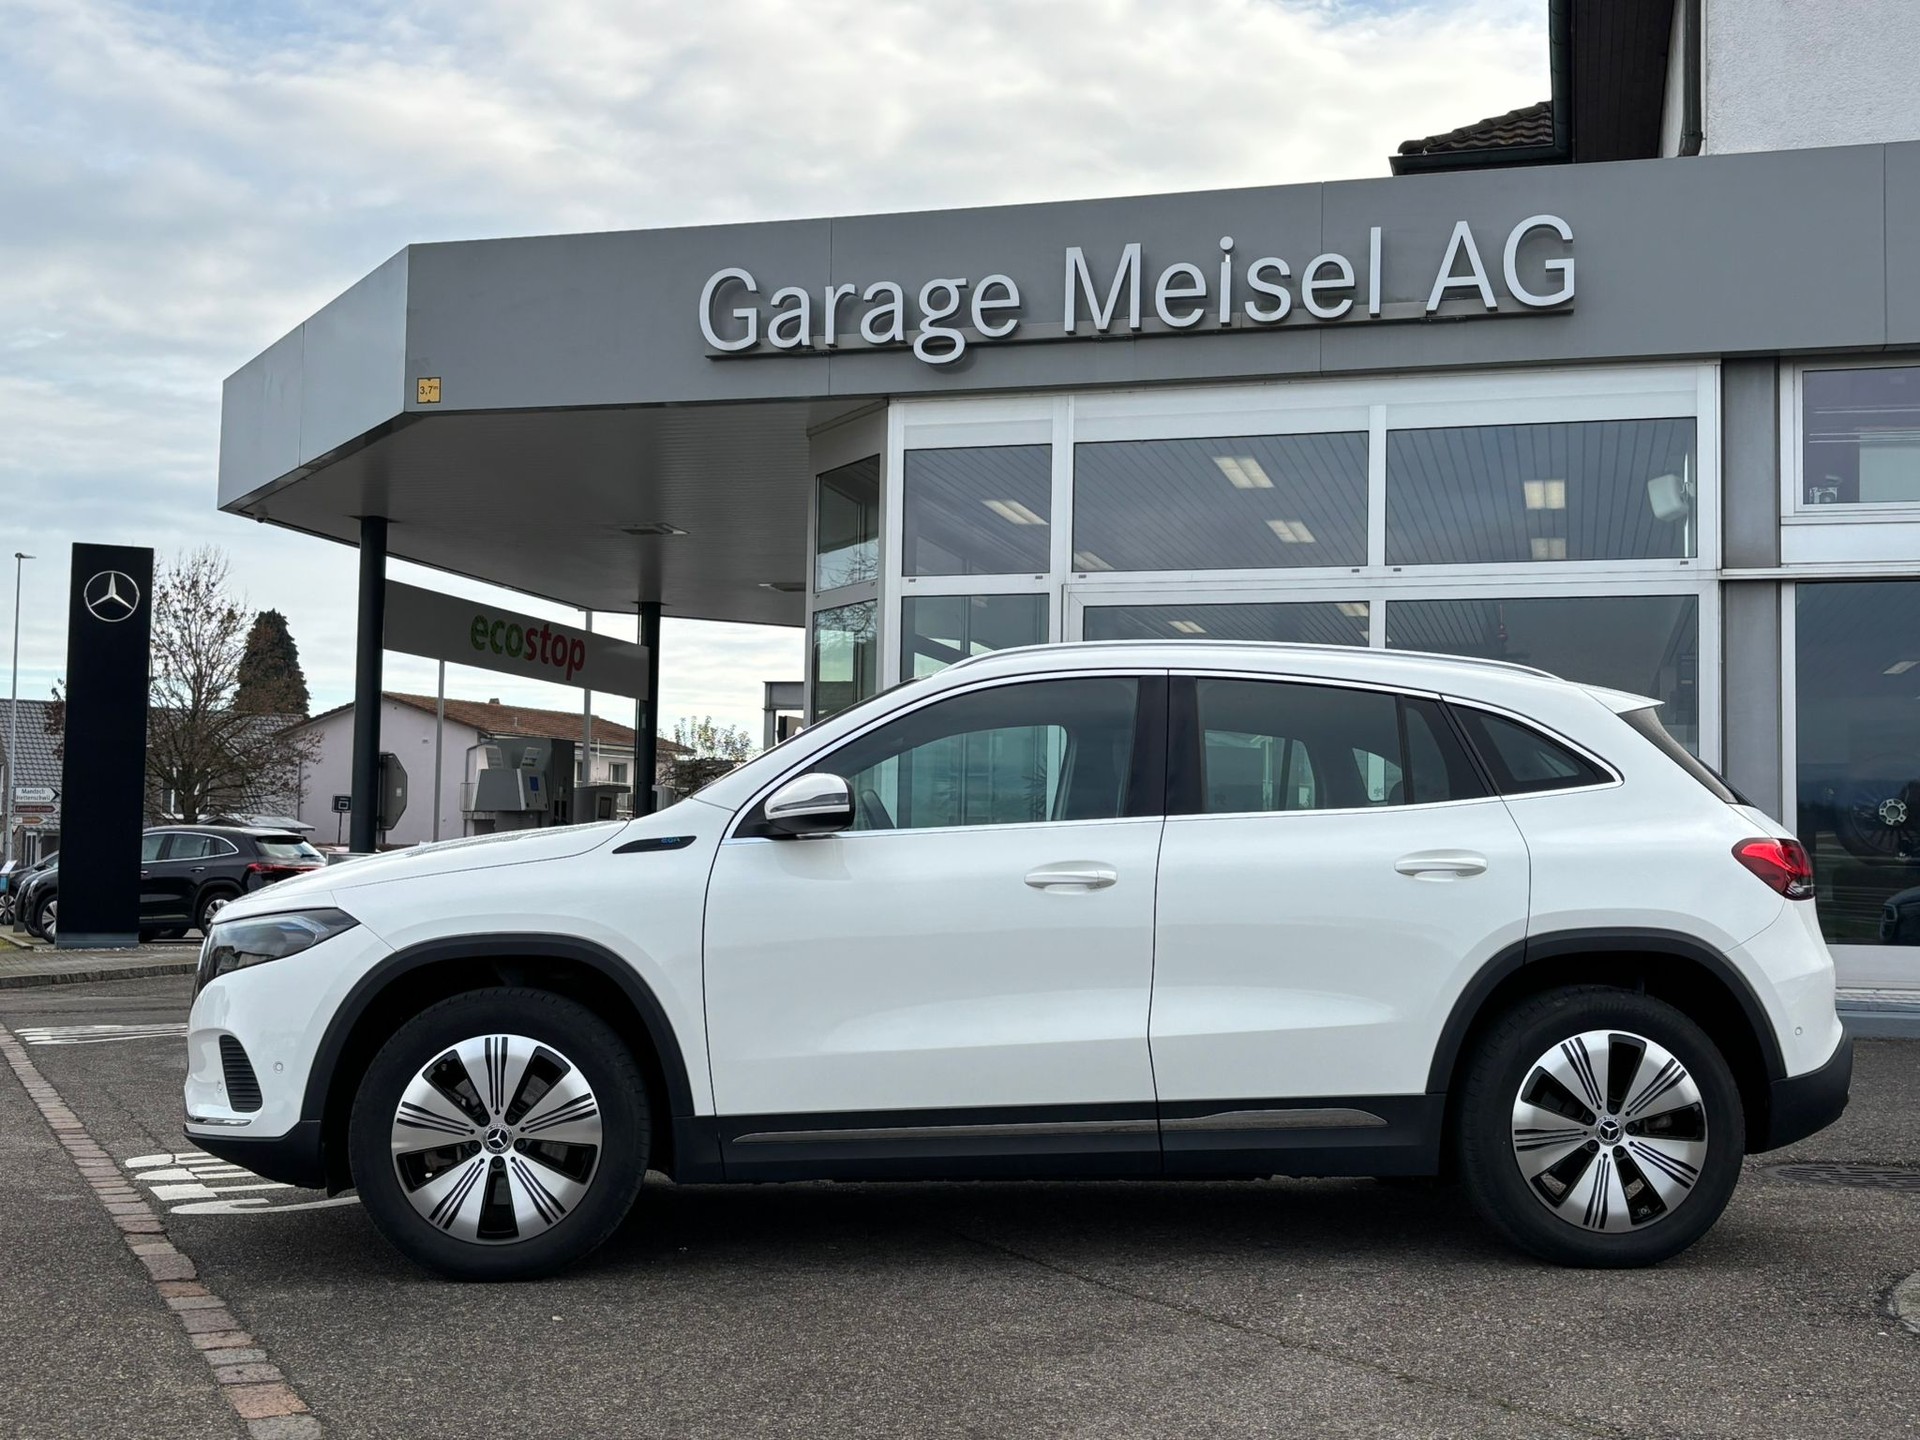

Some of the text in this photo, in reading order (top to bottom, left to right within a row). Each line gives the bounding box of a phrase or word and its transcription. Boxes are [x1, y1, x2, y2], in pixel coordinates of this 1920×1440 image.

[699, 214, 1576, 365] Garage Meisel AG
[470, 614, 586, 681] ecostop
